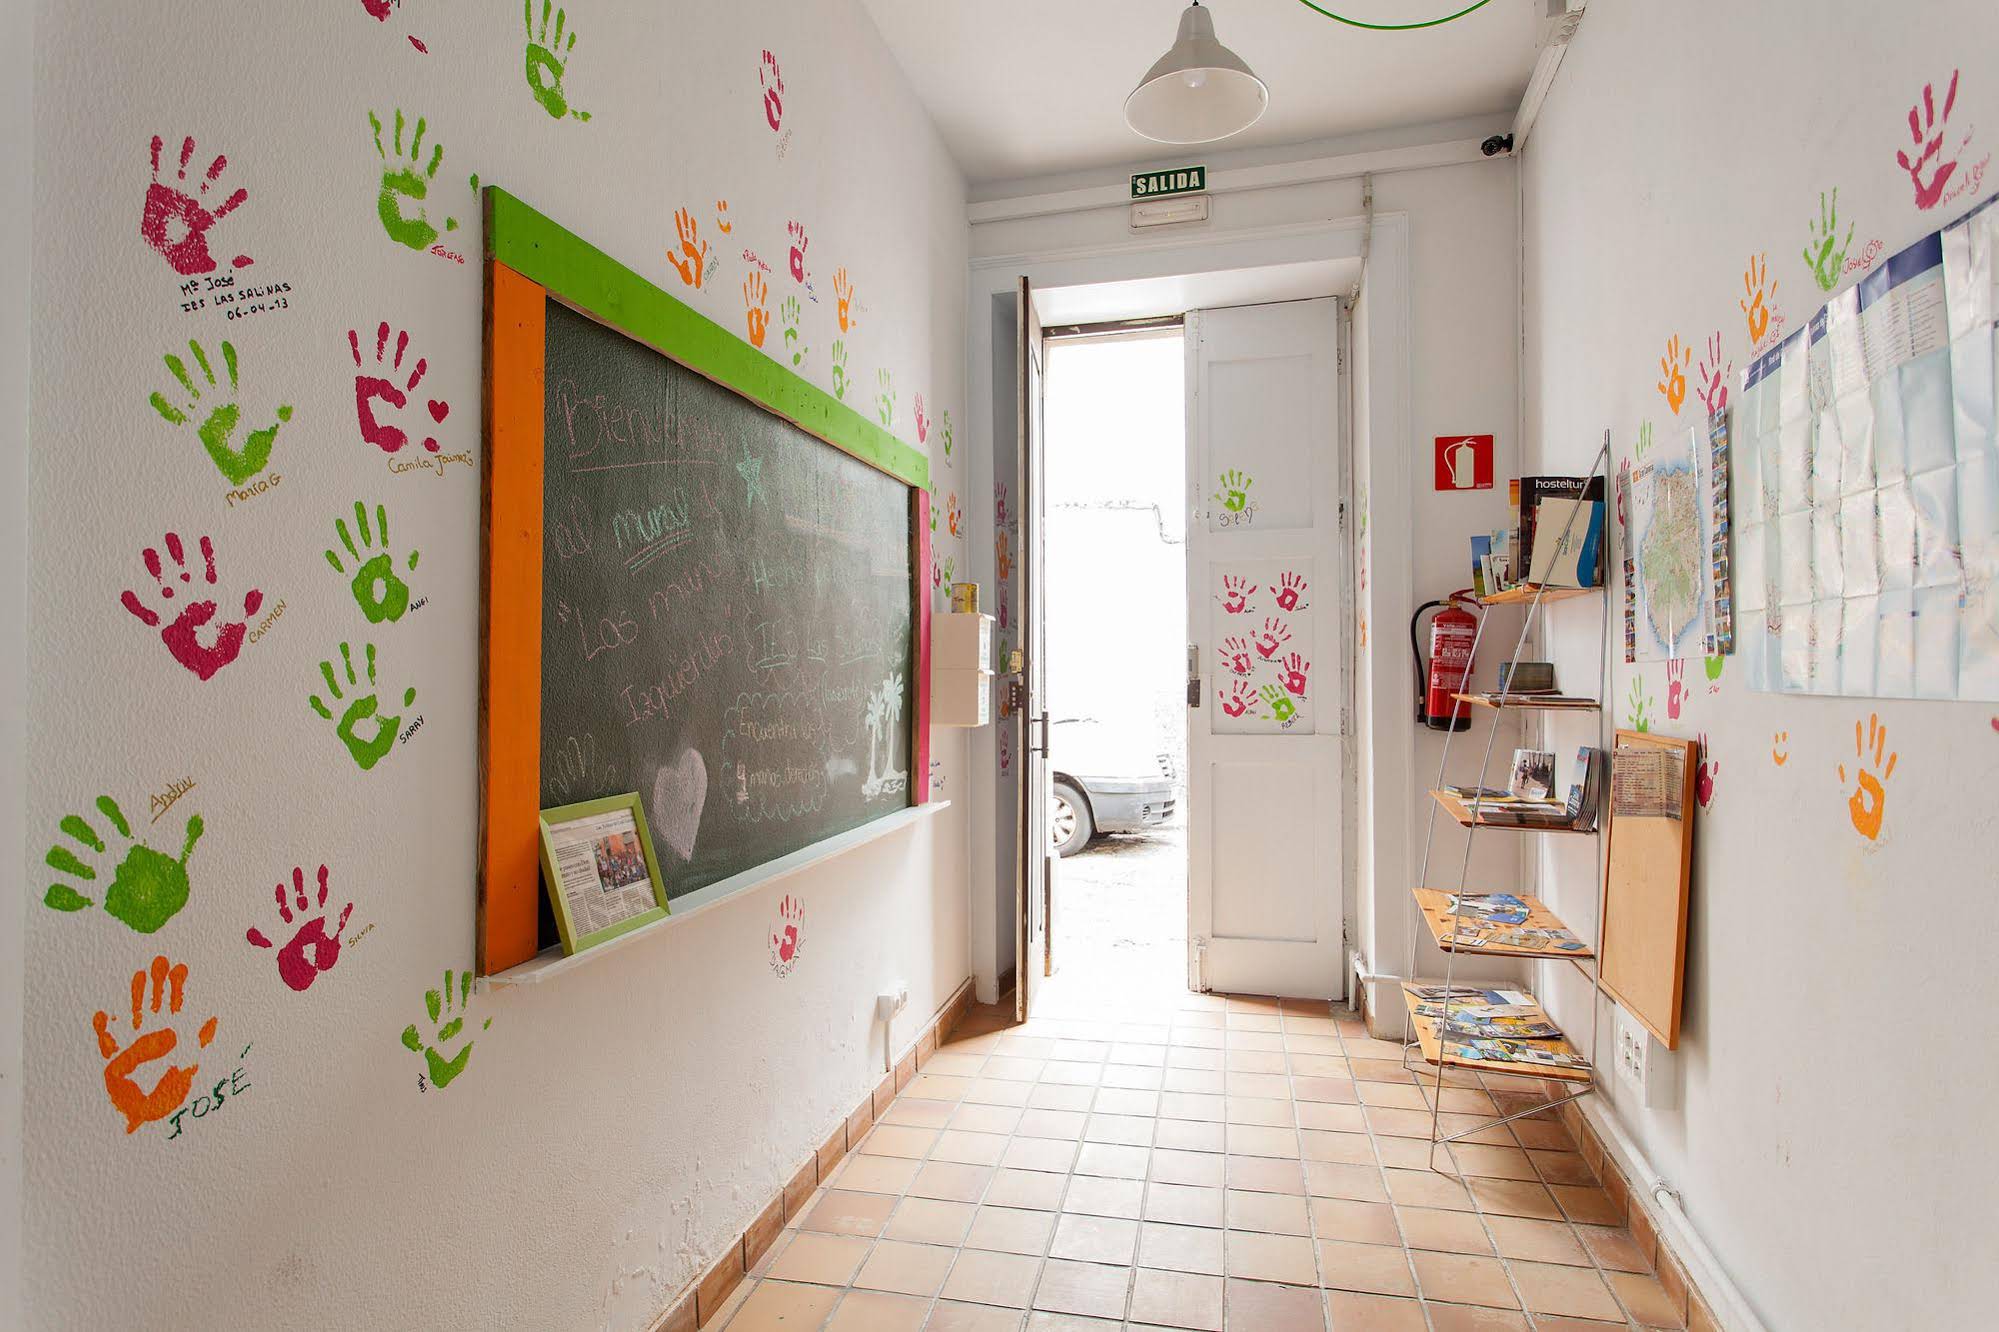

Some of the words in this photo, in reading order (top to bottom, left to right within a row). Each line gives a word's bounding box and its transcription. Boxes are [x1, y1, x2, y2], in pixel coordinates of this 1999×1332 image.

[1136, 171, 1200, 194] SALIDA
[215, 293, 235, 306] LAS
[227, 298, 289, 320] 06-04-13
[388, 455, 434, 474] Camila
[1535, 479, 1584, 489] hosteltur
[399, 715, 424, 744] SARAY
